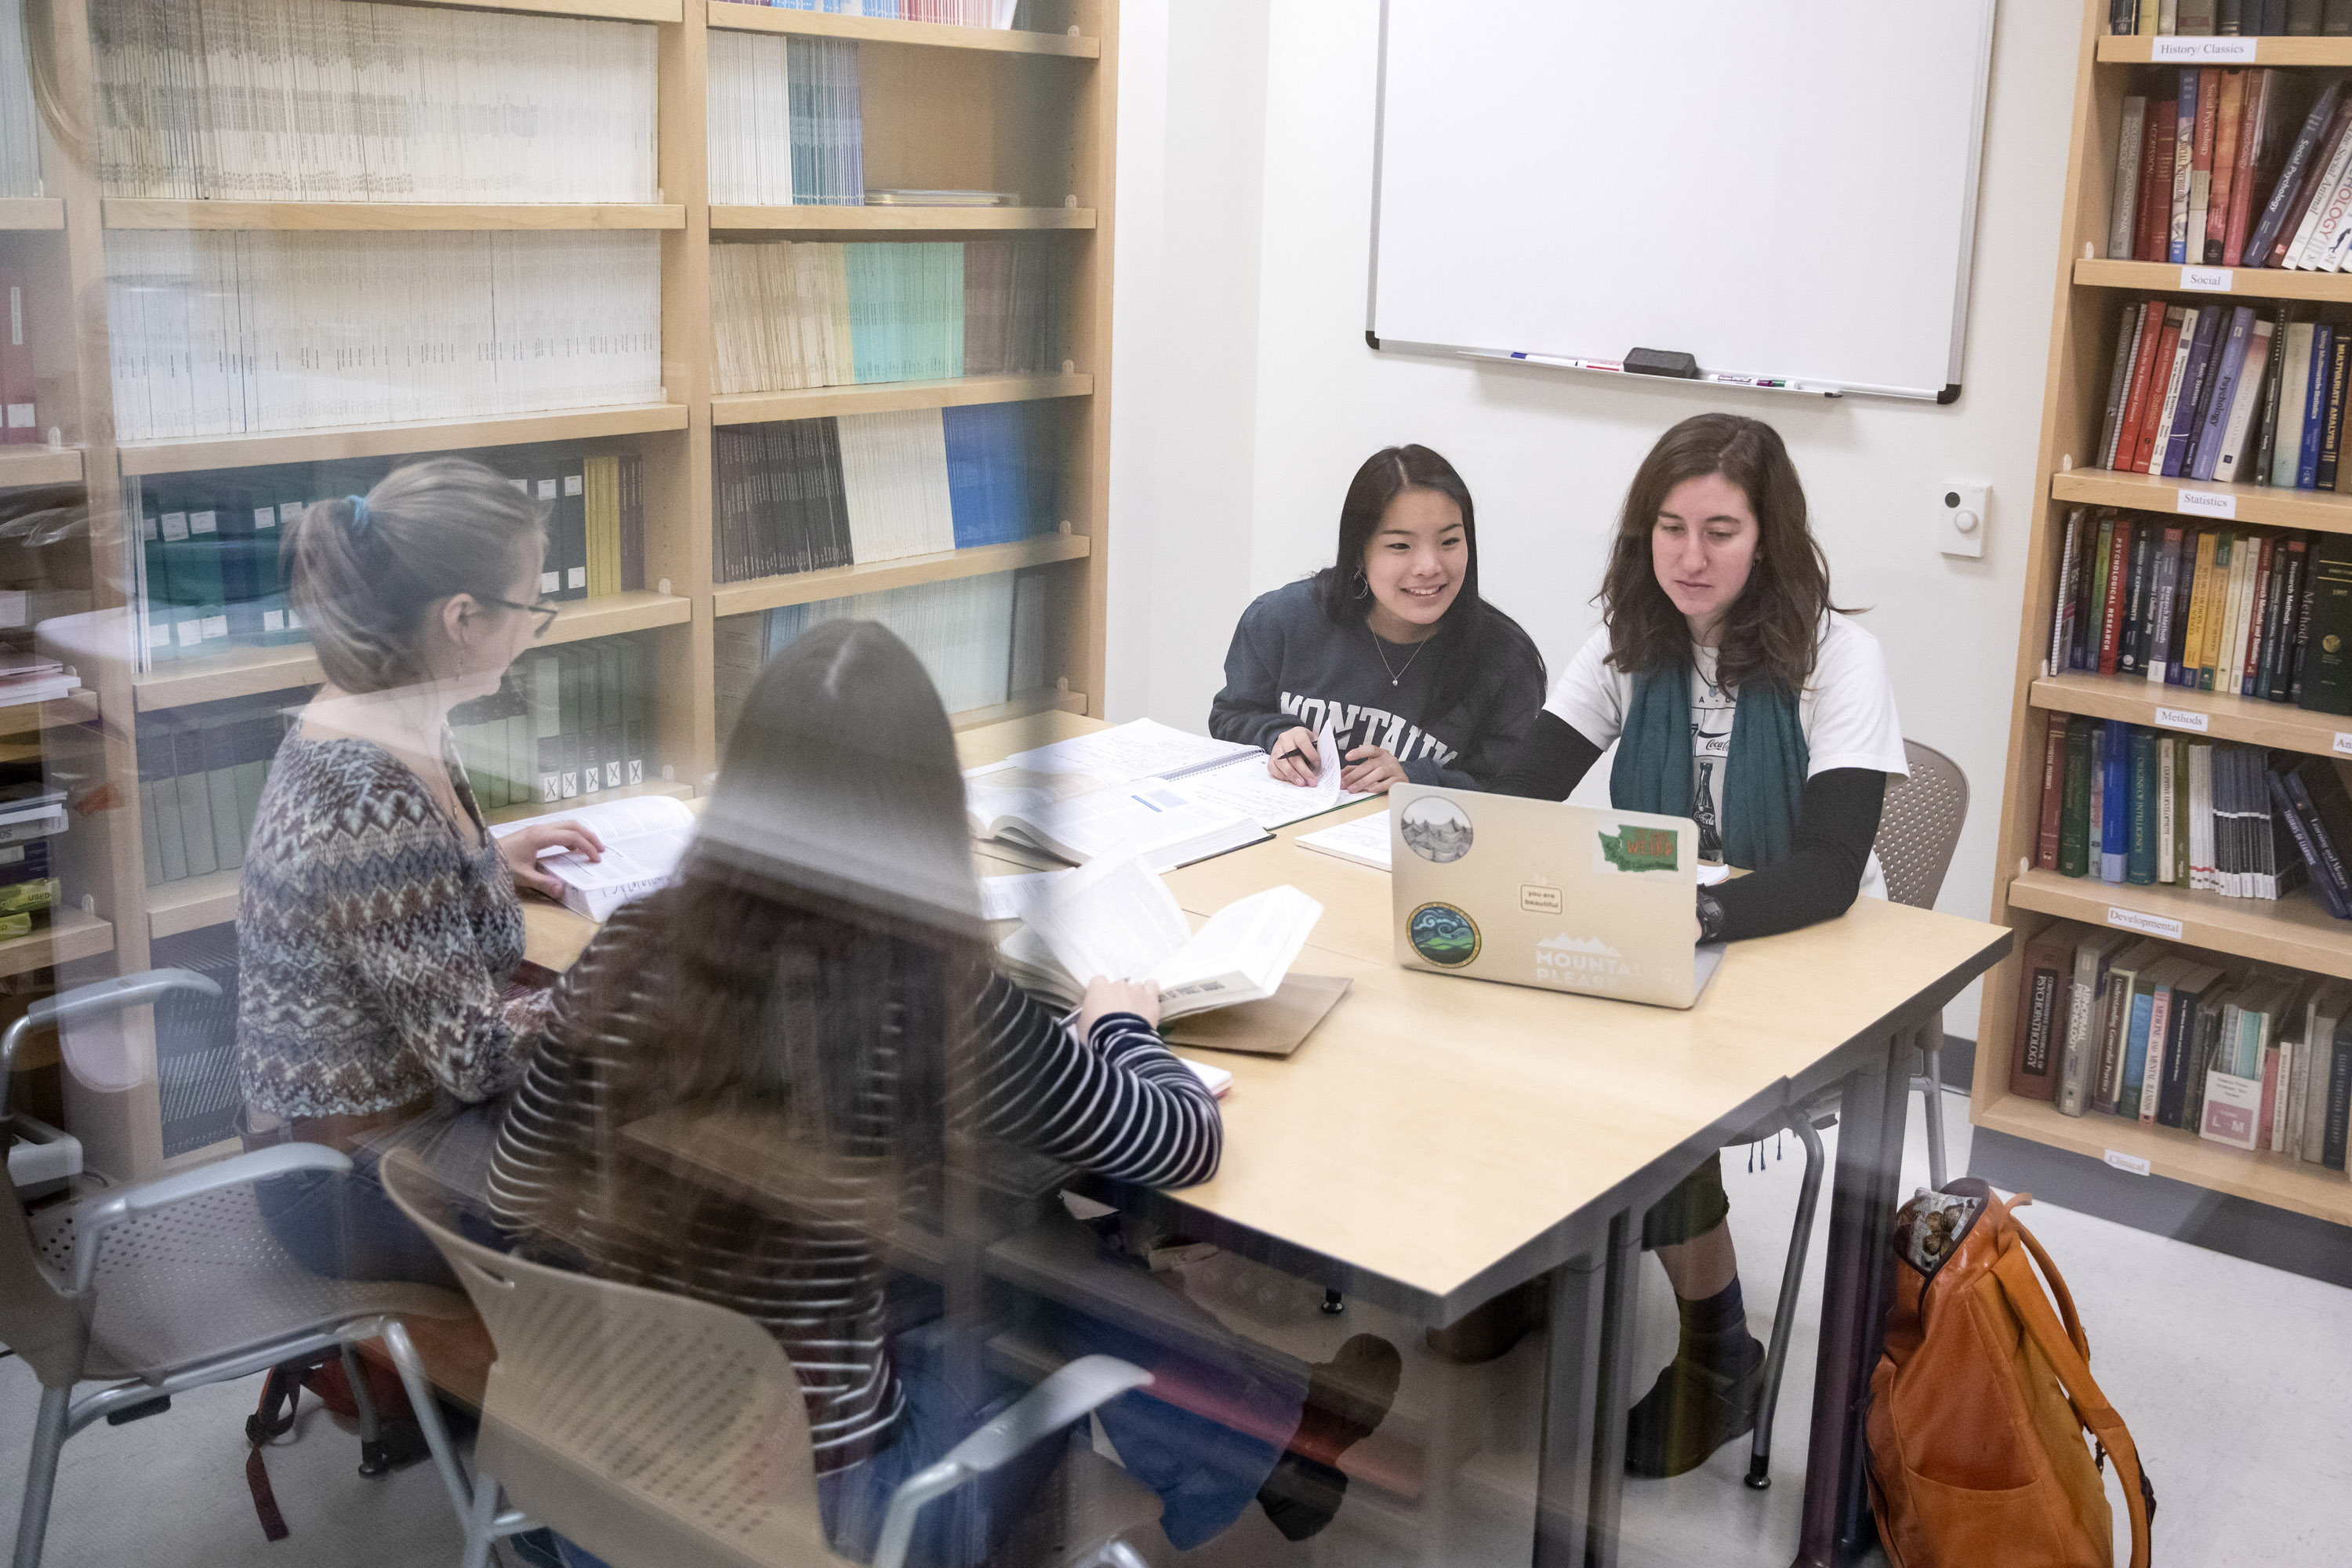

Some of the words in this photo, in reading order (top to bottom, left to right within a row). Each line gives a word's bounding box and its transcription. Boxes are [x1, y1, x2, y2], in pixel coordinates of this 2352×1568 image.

[2161, 43, 2202, 55] History/
[2204, 44, 2245, 55] Classics
[2206, 84, 2215, 108] Social
[2247, 97, 2256, 120] social
[2118, 117, 2129, 170] PSYCHOLOGY
[2147, 122, 2157, 173] AGGRESSION
[2201, 111, 2212, 155] Psychology
[2240, 122, 2252, 170] psychology
[2177, 141, 2189, 163] SOCIAL
[2293, 139, 2309, 165] Social
[2328, 147, 2348, 176] Social
[2174, 164, 2188, 204] PSYCHOLOGY
[2270, 165, 2297, 212] Psychology
[2310, 177, 2332, 215] Animal
[2190, 274, 2221, 286] Social
[2118, 325, 2130, 365] STATISTICS
[2143, 333, 2153, 356] Statistics
[2163, 350, 2172, 361] and
[2165, 333, 2174, 349] Using
[2198, 362, 2206, 378] Basic
[2330, 344, 2346, 405] MULTIVARIATE
[2133, 375, 2144, 401] Behavioral
[2190, 379, 2202, 406] Statistics
[2211, 376, 2231, 427] Psychology
[2129, 402, 2140, 422] Sciences
[2147, 394, 2162, 430] Statistics
[2167, 395, 2177, 419] STATISTICS
[2311, 390, 2321, 419] Statistics
[2325, 407, 2338, 449] ANALYSIS
[2184, 493, 2227, 508] Statistics
[2136, 540, 2146, 565] DESIGN
[2108, 538, 2123, 604] PSYCHOLOGICAL
[2136, 566, 2143, 575] OF
[2244, 557, 2256, 591] RESEARCH
[2259, 570, 2270, 598] Research
[2287, 561, 2297, 593] Research
[2129, 575, 2141, 621] EXPERIMENTS
[2147, 597, 2158, 620] Challenge
[2162, 586, 2173, 615] Research
[2241, 592, 2252, 624] METHODS
[2255, 599, 2266, 624] Methods
[2282, 594, 2293, 625] Methods
[2103, 608, 2114, 651] RESEARCH
[2159, 615, 2170, 644] Methods
[2269, 604, 2279, 638] BEHAVIORAL
[2296, 591, 2314, 645] Methods
[2250, 637, 2260, 664] Statistics
[2265, 639, 2274, 669] RESEARCH
[2161, 710, 2203, 726] Methods
[2136, 789, 2143, 800] OF
[2135, 800, 2143, 853] INTELLIGENCE
[2284, 810, 2299, 833] THEORIES
[2299, 841, 2316, 866] LEARNING
[1627, 840, 1673, 857] WEIRD
[2310, 818, 2331, 848] Learning
[2324, 848, 2336, 862] and
[2330, 862, 2348, 890] Memory
[28, 892, 50, 902] USED
[1525, 899, 1559, 909] beautiful
[1528, 891, 1542, 899] you
[2110, 910, 2180, 933] Developmental
[2042, 976, 2053, 1024] COMPREHENSIVE
[2078, 985, 2092, 1042] ABNORMAL
[2109, 978, 2122, 1028] Understanding
[2027, 975, 2047, 1069] PSYCHOPATHOLOGY
[2068, 982, 2084, 1052] PSYCHOLOGY
[2153, 1004, 2164, 1037] MEDICINE
[2038, 1025, 2048, 1059] HANDBOOK
[2106, 1029, 2117, 1064] Generalist
[2038, 1061, 2043, 1069] OF
[2102, 1065, 2111, 1093] Practice
[2147, 1054, 2158, 1081] MENTAL
[2143, 1083, 2155, 1112] ILLNESS
